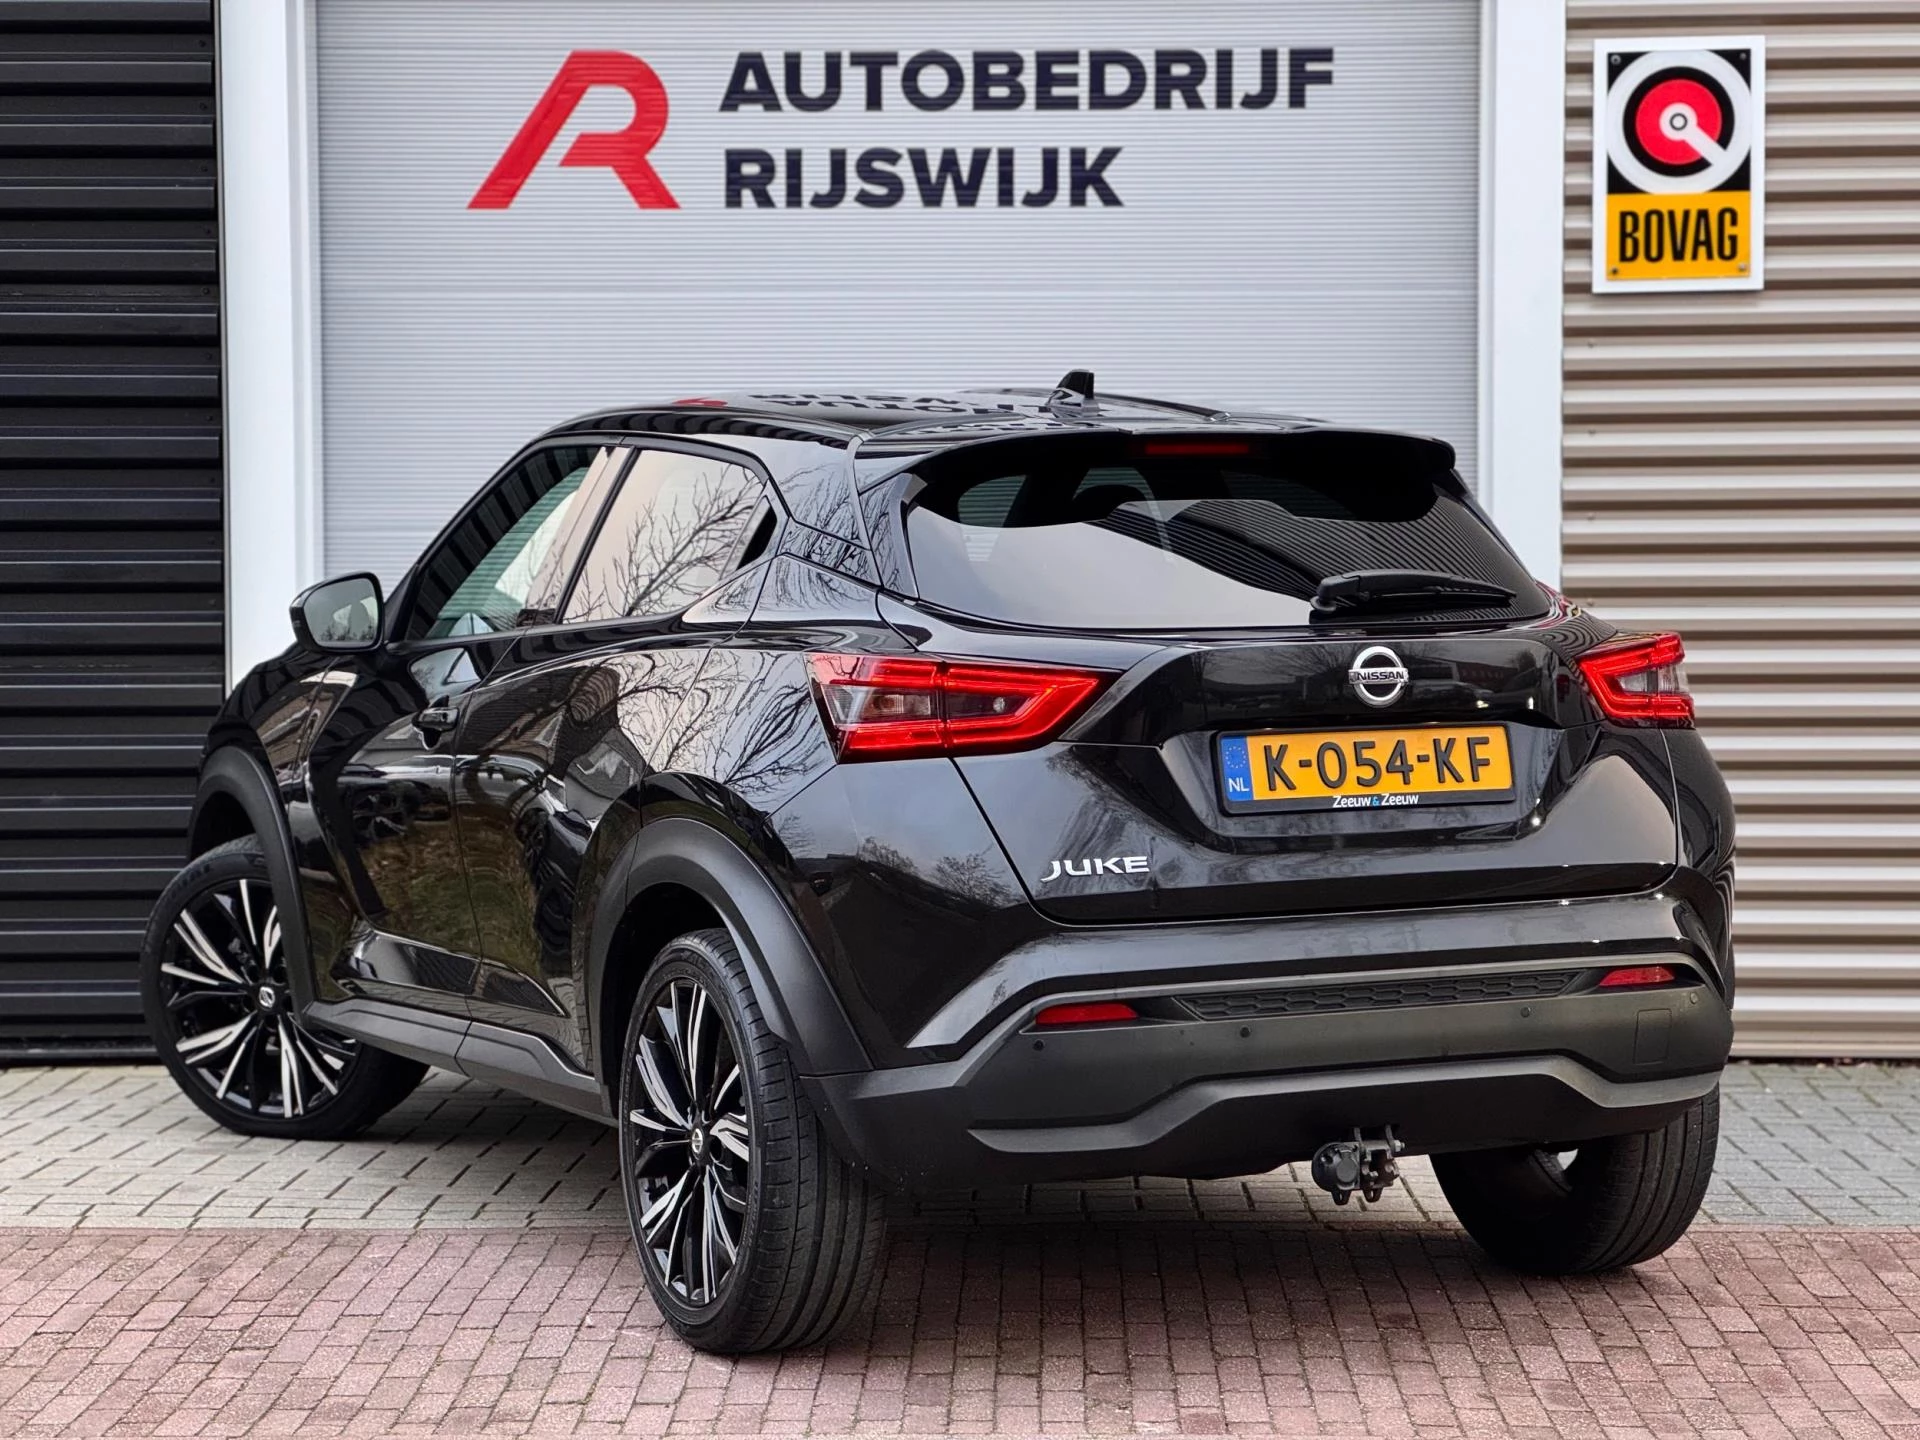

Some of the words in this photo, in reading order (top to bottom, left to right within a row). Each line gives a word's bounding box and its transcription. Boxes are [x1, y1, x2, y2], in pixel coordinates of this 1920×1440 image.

[718, 48, 1334, 113] AUTOBEDRIJF
[724, 147, 1125, 209] RIJSWIJK
[1618, 207, 1739, 263] BOVAG
[1356, 670, 1405, 681] NISSAN
[1263, 735, 1491, 792] K-054-KF
[1227, 776, 1250, 793] NL
[1332, 794, 1371, 808] Zeeuw
[1372, 796, 1380, 806] &
[1381, 793, 1419, 806] Zeeuw
[1040, 856, 1150, 883] JUKE
